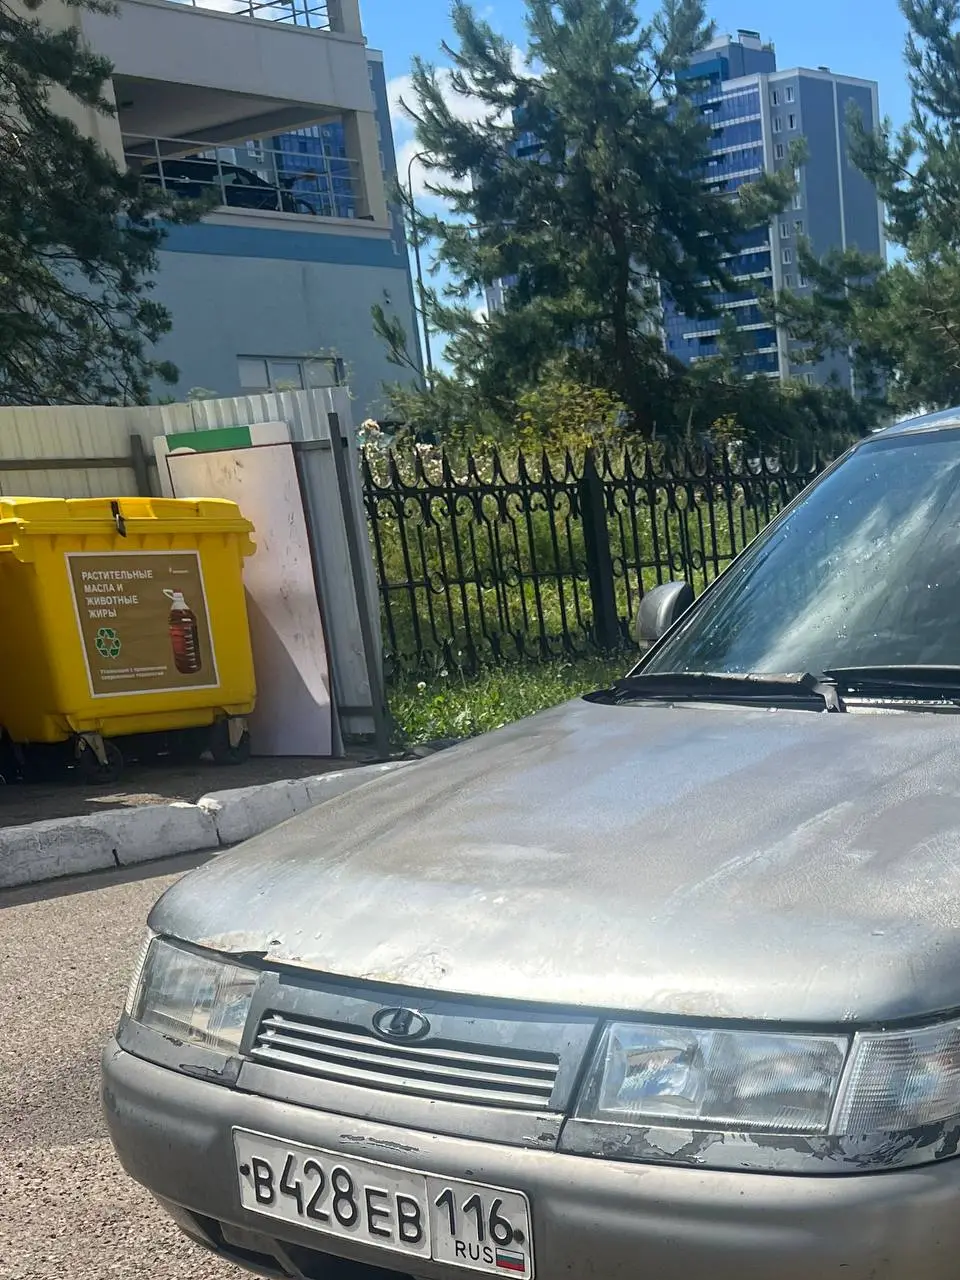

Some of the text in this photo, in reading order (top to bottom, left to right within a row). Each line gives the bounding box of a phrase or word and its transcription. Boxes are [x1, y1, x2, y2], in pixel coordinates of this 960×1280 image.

[82, 569, 154, 580] РАСТИТЕЛЬНЫЕ
[84, 583, 124, 593] МАСЛА И
[86, 595, 139, 606] ЖИВОТНЫЕ
[88, 608, 117, 619] ЖИРЫ
[435, 1187, 514, 1246] 116
[455, 1240, 495, 1264] RUS
